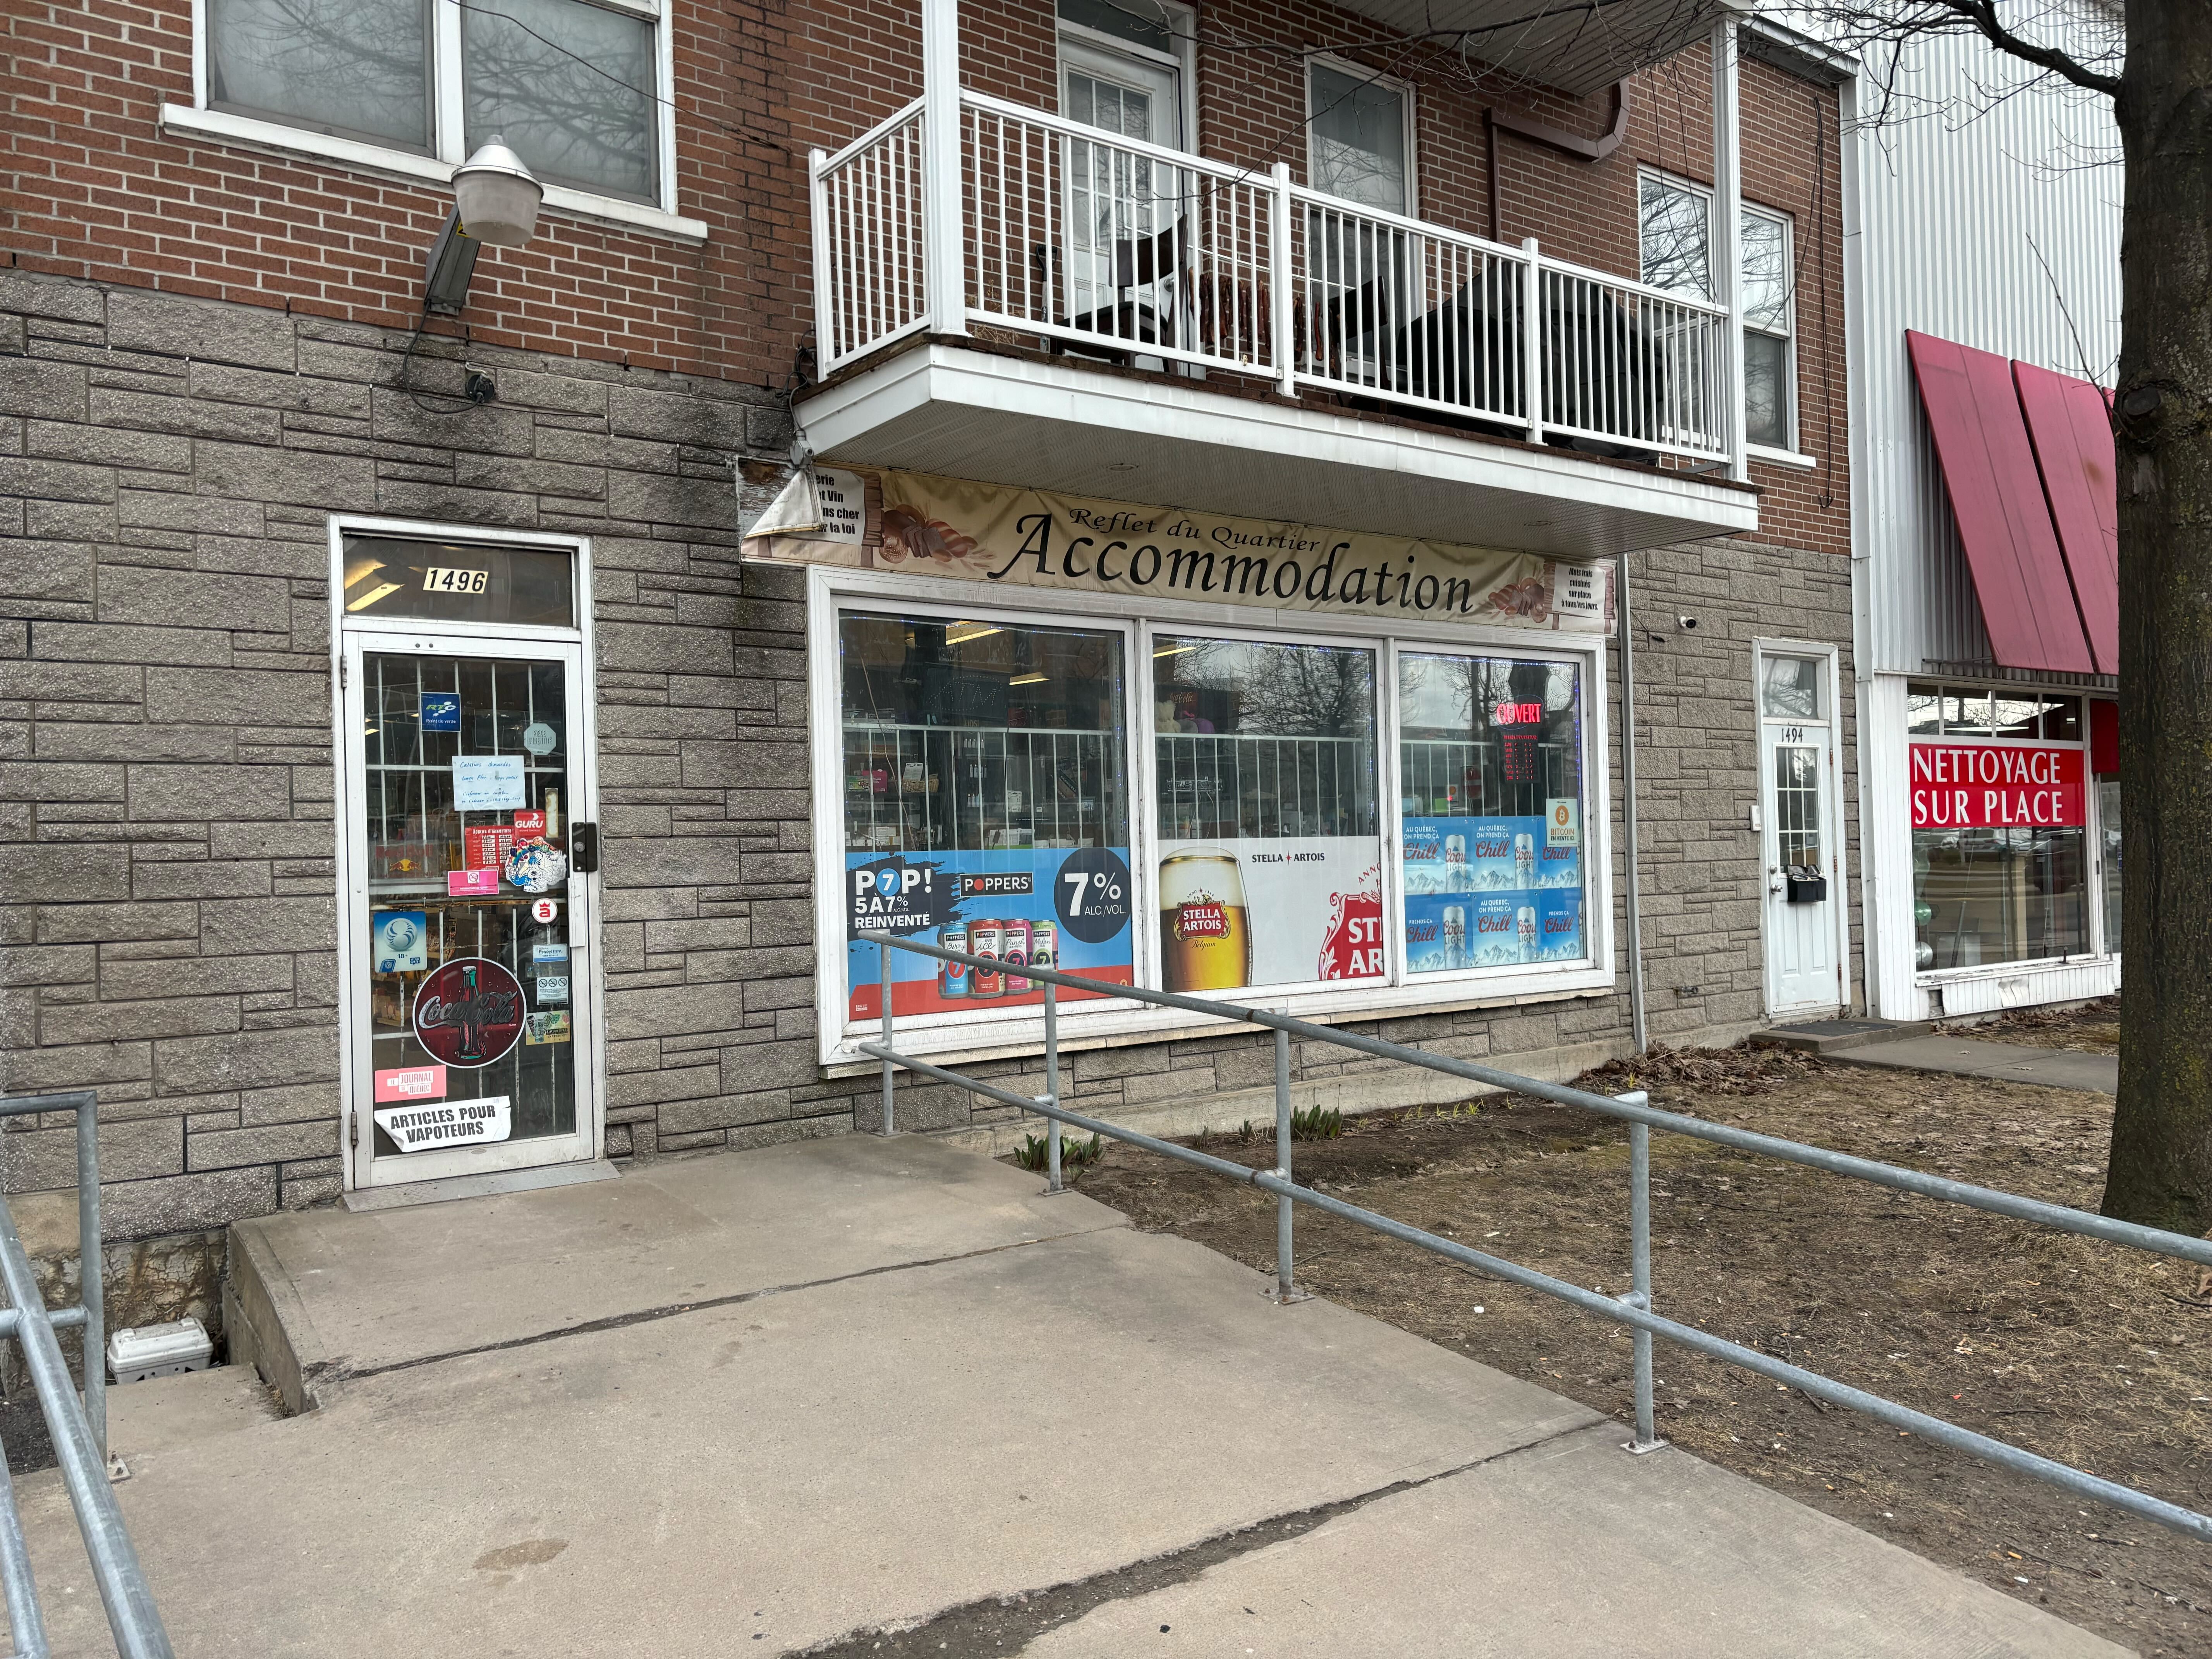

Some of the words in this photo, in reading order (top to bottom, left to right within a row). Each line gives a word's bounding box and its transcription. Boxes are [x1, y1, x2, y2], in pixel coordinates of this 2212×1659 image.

[828, 490, 843, 503] Vin
[837, 508, 859, 519] cher
[830, 522, 840, 533] la
[842, 523, 855, 534] loi
[1069, 508, 1157, 533] Reflet
[1167, 520, 1200, 539] du
[1211, 527, 1320, 552] Quartier
[987, 514, 1472, 613] Accommodation
[1569, 567, 1580, 576] Mets
[1582, 569, 1593, 577] frais
[430, 569, 485, 592] 1496
[1570, 579, 1590, 588] cuisinés
[1578, 591, 1591, 599] place
[1585, 601, 1598, 610] jours.
[935, 682, 997, 706] ATM
[1496, 703, 1541, 724] OUVERT
[1781, 727, 1803, 743] 1494
[1914, 748, 2061, 784] NETTOYAGE
[1914, 790, 1970, 824] SUR
[1985, 790, 2063, 823] PLACE
[515, 820, 543, 828] GURU
[1414, 824, 1437, 833] QUÉBEC,
[1403, 842, 1440, 860] Chill
[1476, 840, 1510, 858] Chill
[1542, 847, 1571, 860] Chill
[1252, 854, 1283, 863] STELLA
[1294, 852, 1325, 862] ARTOIS
[1447, 863, 1465, 871] LIGHT
[1065, 872, 1121, 917] 7%
[855, 897, 867, 914] 5
[869, 892, 884, 913] À
[855, 911, 930, 929] RÉINVENTÉ
[1183, 909, 1221, 920] STELLA
[1183, 920, 1221, 931] ARTOIS
[1478, 914, 1512, 933] Chill
[1545, 917, 1574, 933] Chill
[1406, 925, 1438, 943] Chill
[1445, 936, 1465, 945] LIGHT
[1518, 934, 1536, 942] LIGHT
[1190, 940, 1216, 950] Belgium
[1348, 948, 1383, 975] AR
[400, 1073, 431, 1084] JOURNAL
[391, 1109, 455, 1130] ARTICLES
[459, 1105, 496, 1120] POUR
[405, 1121, 484, 1143] VAPOTEURS
